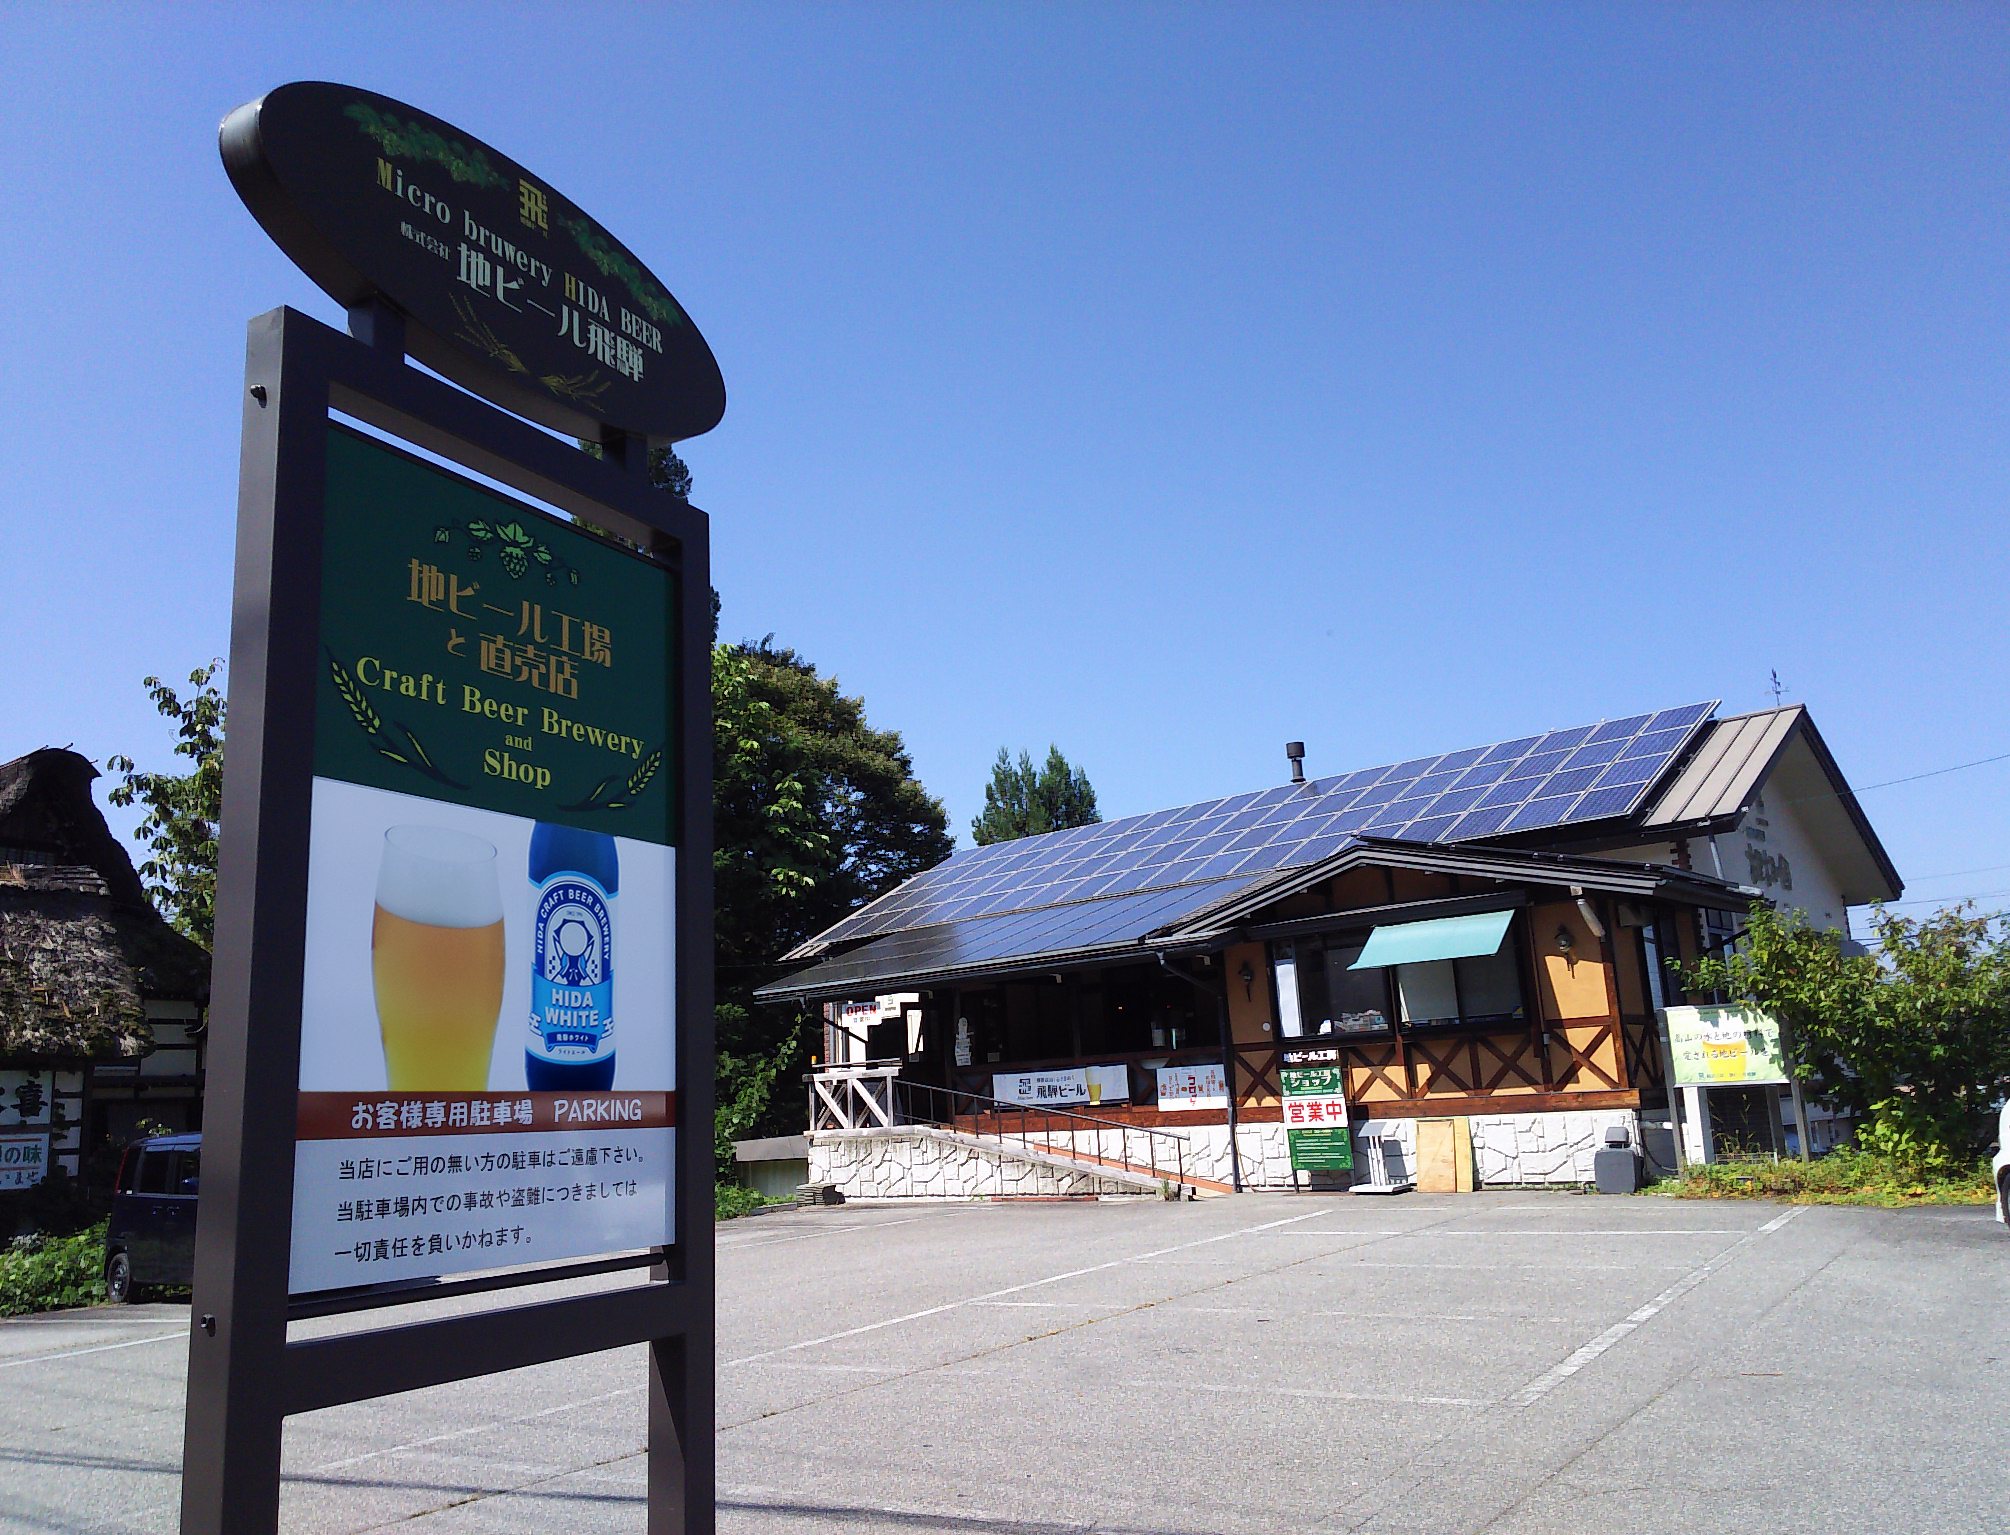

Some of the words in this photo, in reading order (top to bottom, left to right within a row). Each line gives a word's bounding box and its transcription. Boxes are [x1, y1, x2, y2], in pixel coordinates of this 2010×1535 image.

[377, 157, 451, 224] Micro
[464, 209, 552, 287] bruwery
[564, 272, 610, 323] HIDA
[621, 306, 663, 354] BEER
[400, 221, 450, 261] 株式会社
[456, 242, 644, 382] 地ビール飛騨
[407, 557, 612, 668] 地ビール工場
[480, 632, 578, 699] 直売店
[356, 656, 447, 705] Craft
[462, 684, 529, 726] Beer
[541, 707, 644, 758] Brewery
[505, 732, 533, 752] and
[484, 749, 551, 789] Shop
[540, 889, 564, 918] CRAFT
[568, 889, 594, 906] BEER
[537, 922, 545, 954] HIDA
[593, 903, 610, 960] BREWERY
[552, 988, 594, 1008] HIDA
[846, 1004, 876, 1016] OPEN
[545, 1006, 599, 1028] WHITE
[1290, 1074, 1332, 1088] ショップ
[351, 1099, 534, 1130] お客様専用駐車場
[554, 1098, 642, 1122] PARKING
[1288, 1100, 1342, 1123] 営業中
[0, 1144, 42, 1164] の味
[338, 1146, 644, 1181] 当店にご用の無い方の駐車はご遠慮下さい。
[336, 1180, 638, 1222] 当駐車場内での事故や盗難につきましては
[334, 1225, 532, 1263] 一切責任を負いかねます。
